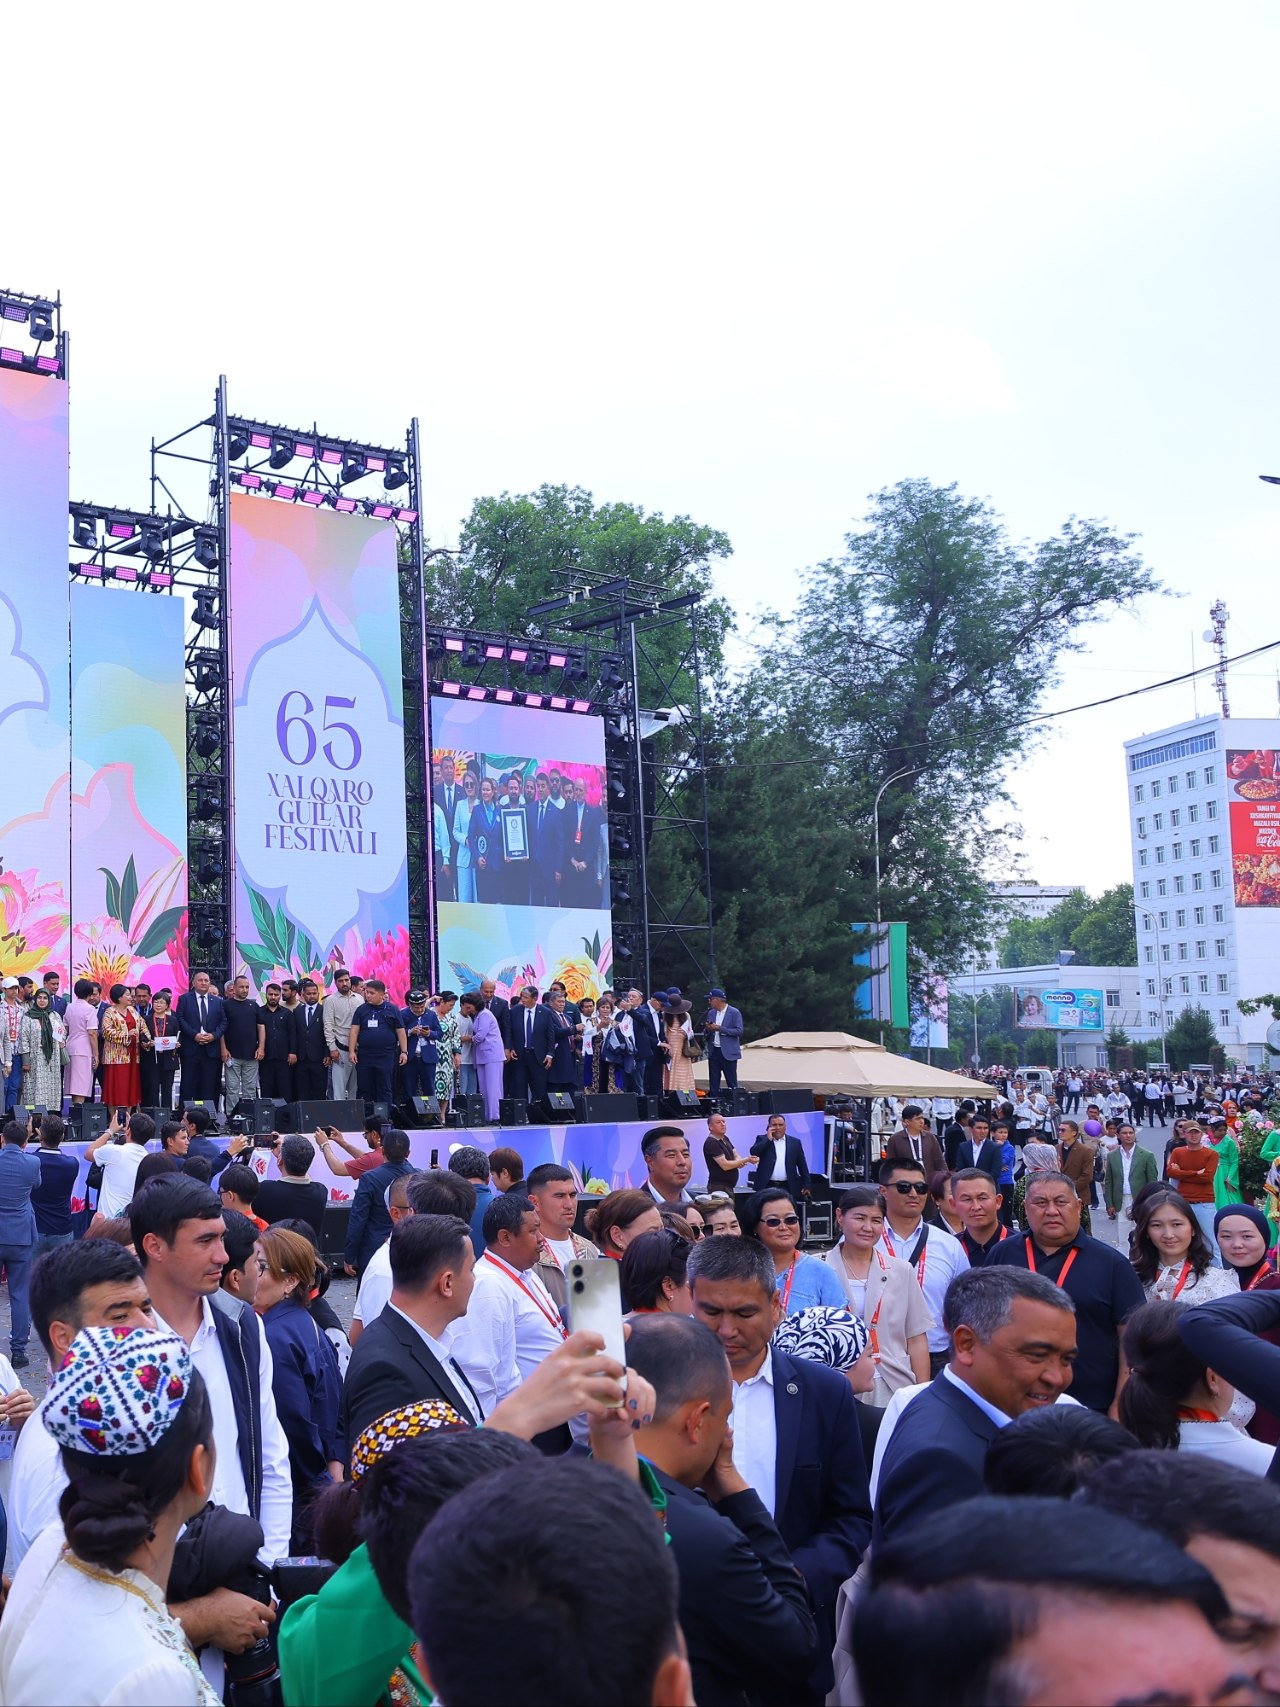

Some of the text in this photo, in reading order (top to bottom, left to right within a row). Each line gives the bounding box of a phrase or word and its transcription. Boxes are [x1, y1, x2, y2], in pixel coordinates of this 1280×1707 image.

[276, 690, 362, 771] 65
[267, 772, 373, 805] XALQARO
[264, 824, 377, 855] FESTIVALI
